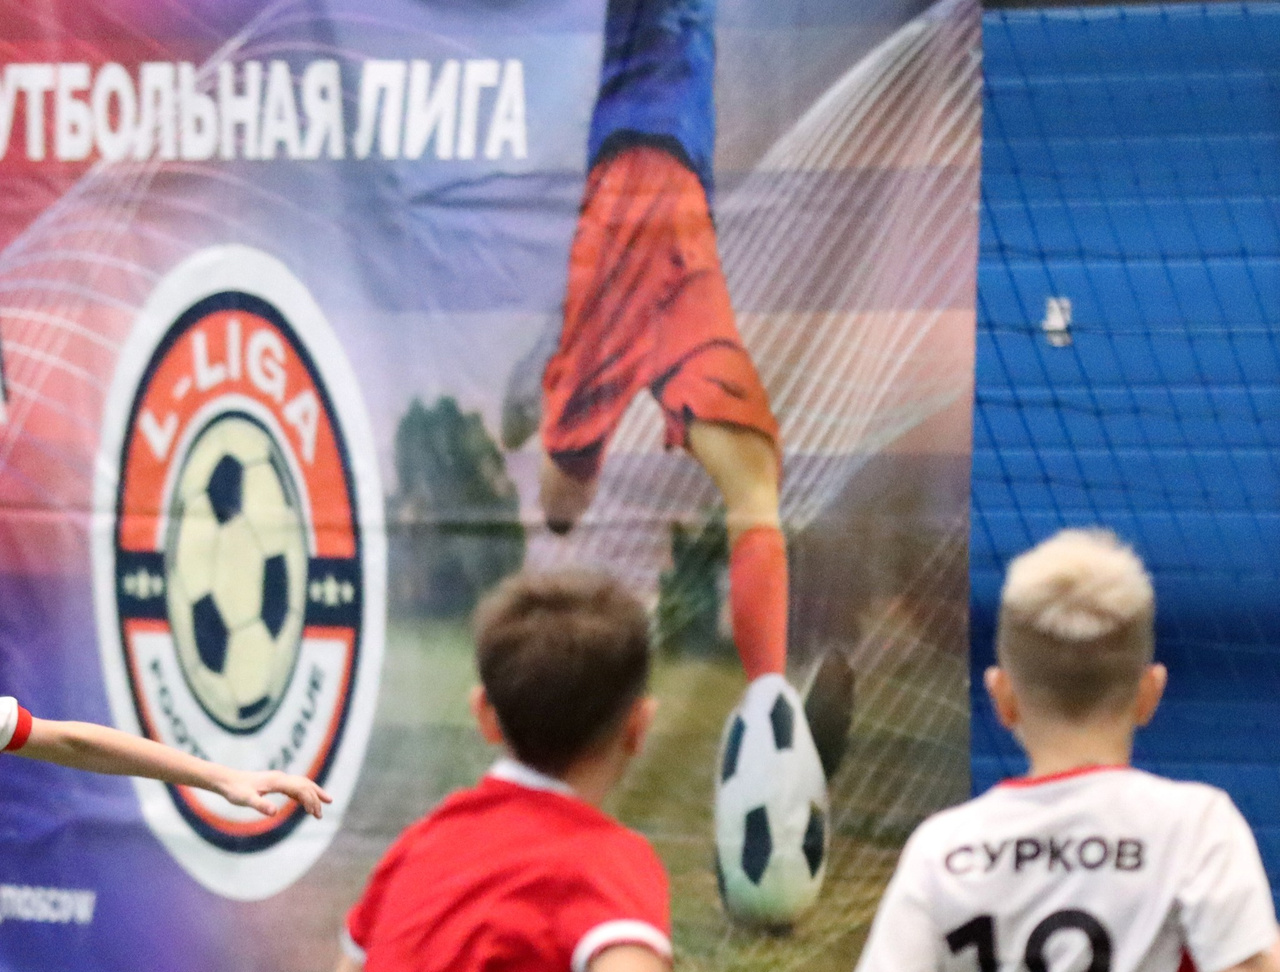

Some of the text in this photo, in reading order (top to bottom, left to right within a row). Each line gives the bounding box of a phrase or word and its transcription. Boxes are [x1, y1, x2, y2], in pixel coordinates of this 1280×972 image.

[352, 58, 529, 161] ЛИГА
[138, 317, 320, 467] L-LIGA
[944, 835, 1147, 876] СУРКОВ
